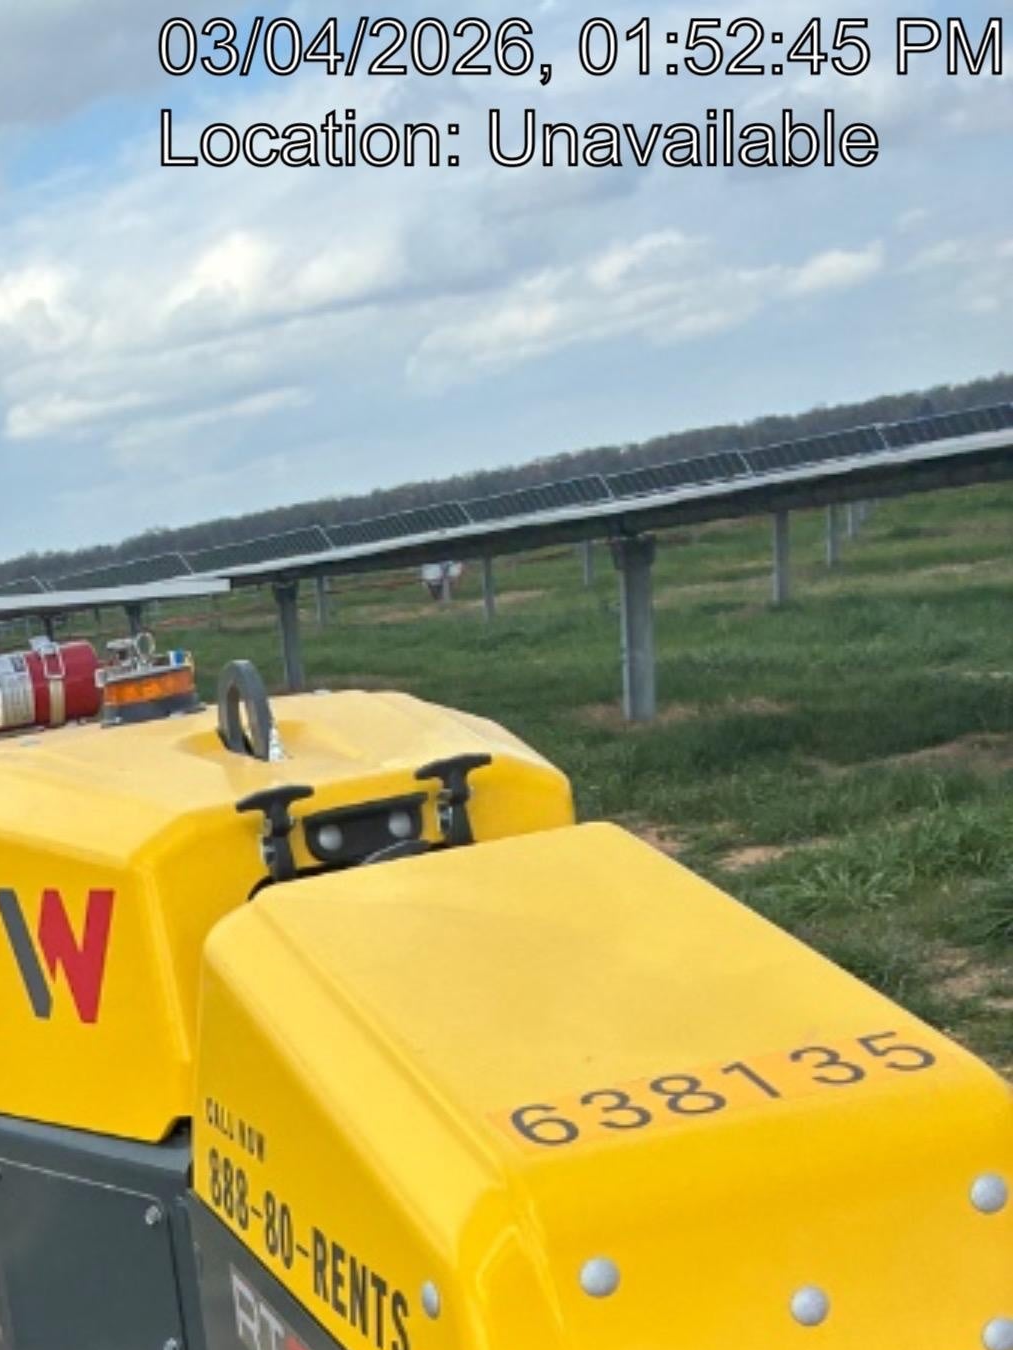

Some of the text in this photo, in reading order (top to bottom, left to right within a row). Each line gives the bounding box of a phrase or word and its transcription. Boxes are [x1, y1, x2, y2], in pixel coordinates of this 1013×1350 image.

[205, 1097, 265, 1163] CALL NOW
[510, 1032, 936, 1147] 638135
